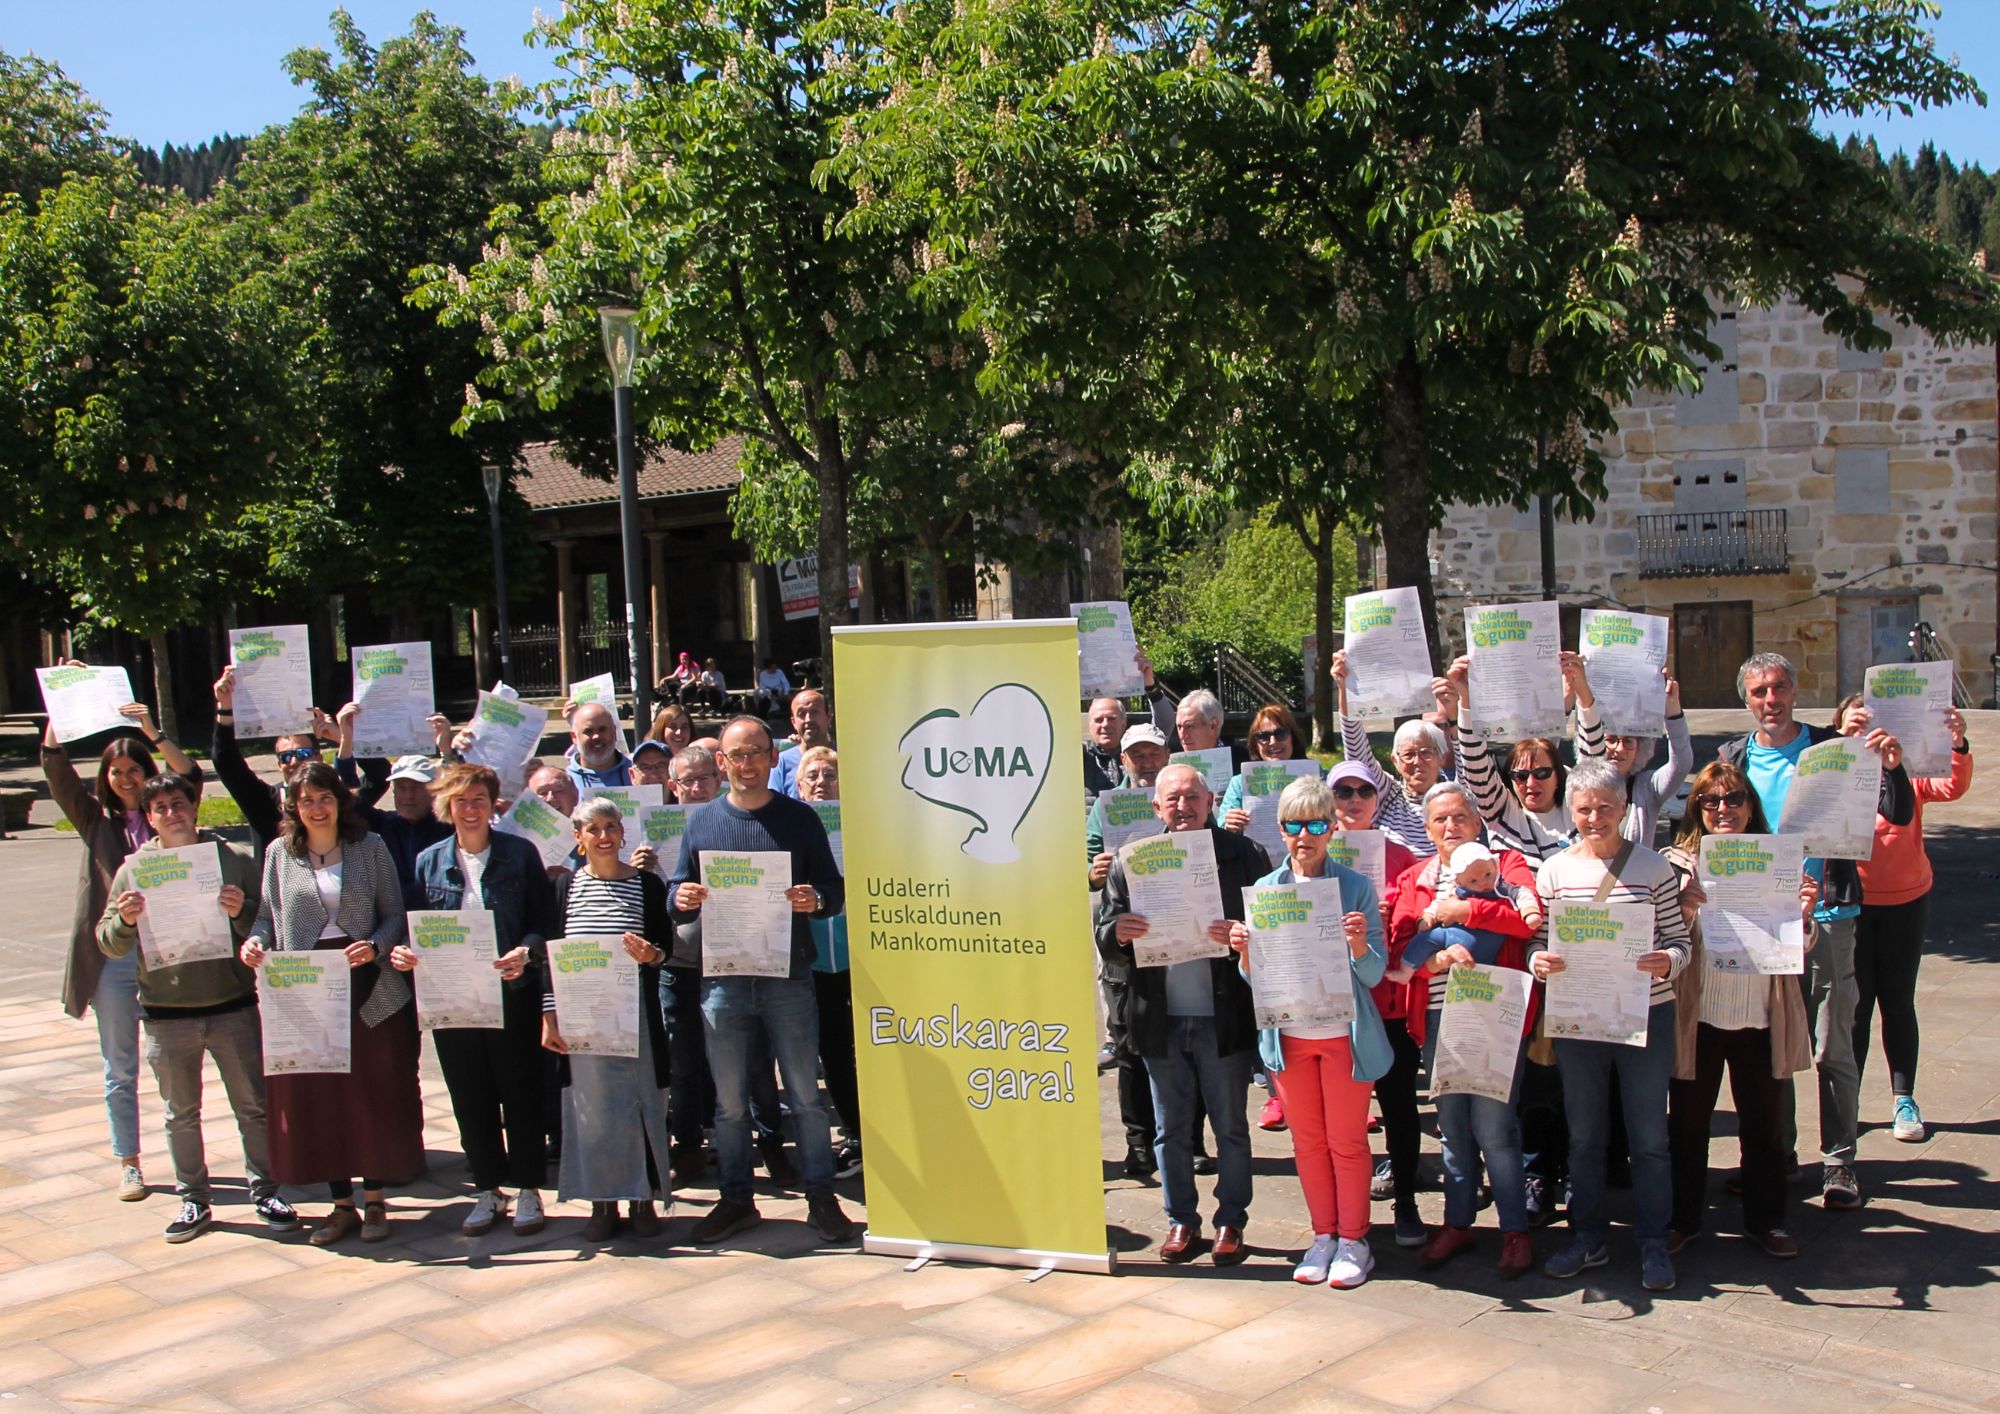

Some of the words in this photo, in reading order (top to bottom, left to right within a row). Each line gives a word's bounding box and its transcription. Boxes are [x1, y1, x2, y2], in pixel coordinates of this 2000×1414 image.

[1478, 610, 1518, 620] Udalerri
[1472, 620, 1532, 631] Euskaldunen
[1716, 840, 1759, 850] Udalerri
[1706, 850, 1774, 861] Euskaldunen
[867, 877, 950, 898] Udalerri
[1256, 890, 1297, 902] Udalerri
[1249, 900, 1312, 912] Euskaldunen
[1565, 906, 1610, 918] Udalerri
[868, 904, 1002, 926] Euskaldunen
[1554, 916, 1624, 928] Euskaldunen
[870, 930, 1046, 954] Mankomunitatea
[870, 1004, 1069, 1053] Euskaraz
[968, 1060, 1075, 1109] gara!
